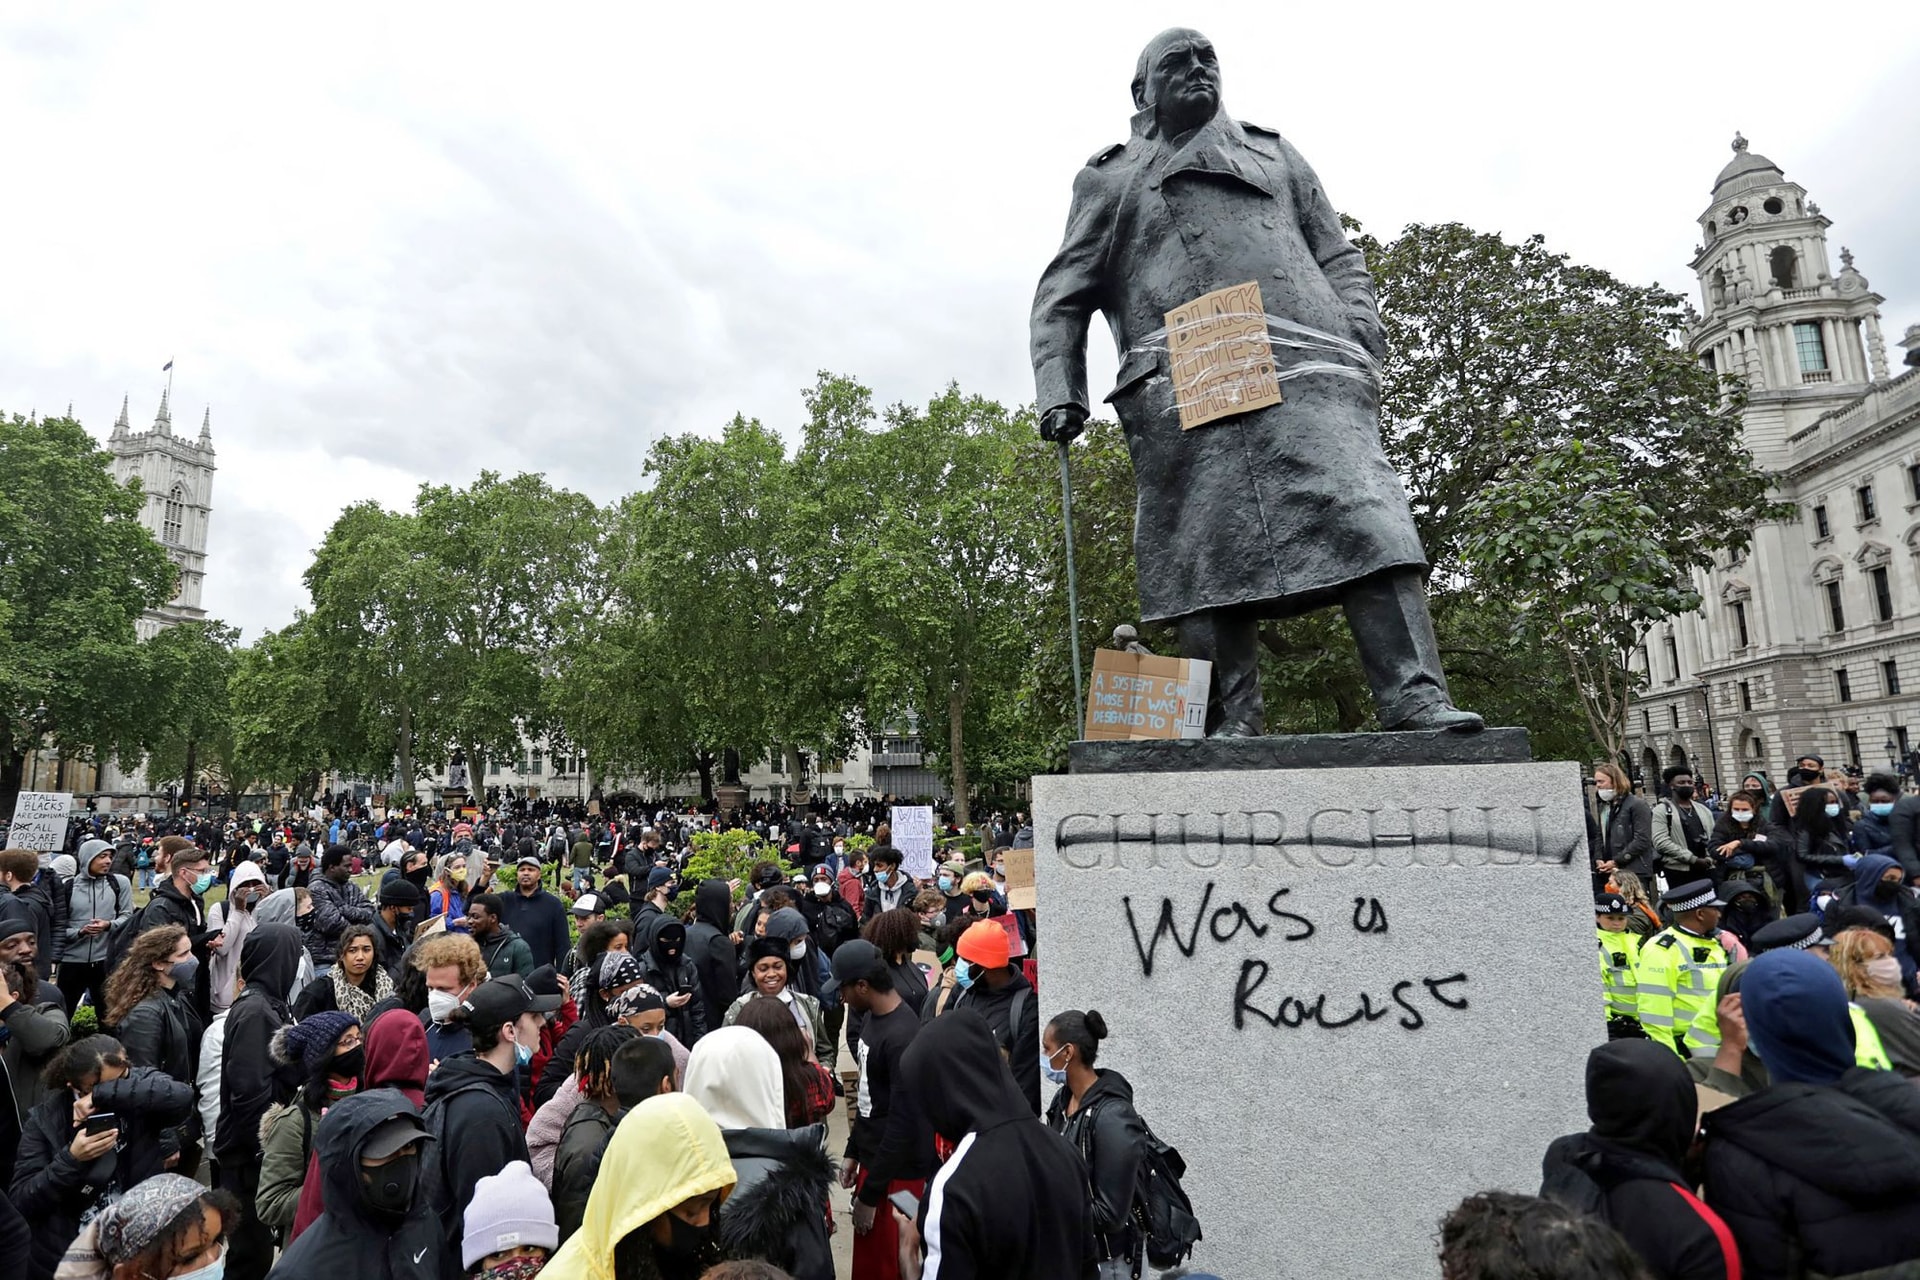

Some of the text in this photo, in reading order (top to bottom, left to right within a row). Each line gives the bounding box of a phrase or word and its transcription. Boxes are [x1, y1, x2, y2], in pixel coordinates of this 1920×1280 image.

[1171, 284, 1264, 347] BLACK
[1175, 324, 1271, 386] LIVES
[1180, 362, 1280, 422] MATTER
[1095, 673, 1104, 691] A
[1112, 675, 1153, 693] SYSTEM
[1094, 692, 1124, 707] THOSE
[1129, 695, 1143, 710] IT
[1148, 699, 1177, 715] WAS
[1092, 708, 1146, 727] DESIGNED
[1146, 714, 1166, 730] TO
[23, 801, 65, 811] BLACKS
[38, 794, 58, 802] ALL
[16, 812, 33, 820] ARE
[897, 807, 927, 823] WE
[33, 824, 53, 832] ALL
[892, 821, 931, 836] STAND
[11, 833, 58, 843] COPS ARE
[18, 842, 55, 851] RACIST
[897, 837, 931, 849] WITH
[1056, 805, 1566, 873] CHURCHILL
[900, 848, 931, 869] YOU
[1122, 882, 1389, 977] Was a
